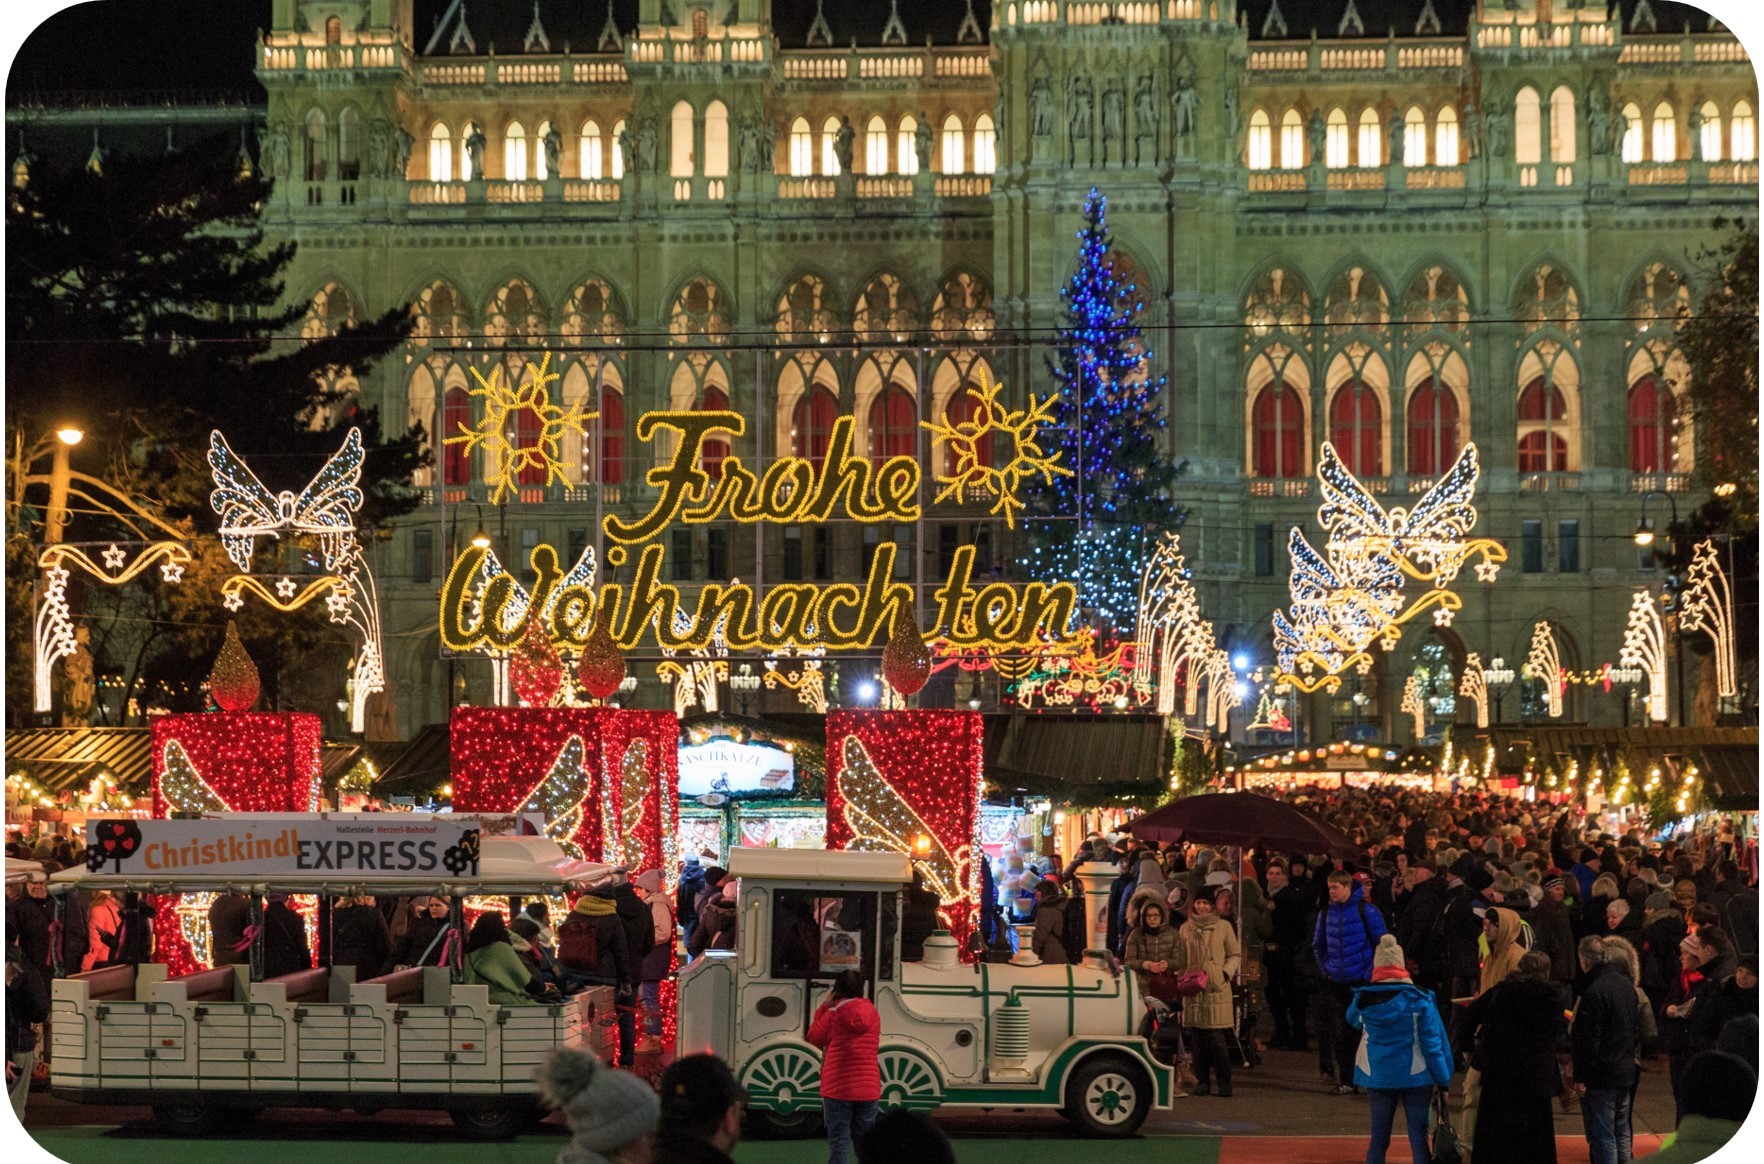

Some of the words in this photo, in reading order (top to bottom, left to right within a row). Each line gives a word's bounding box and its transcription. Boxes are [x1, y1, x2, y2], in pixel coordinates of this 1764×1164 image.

[602, 410, 922, 545] Frohe
[440, 543, 1083, 650] Weihnachten
[144, 828, 300, 870] Christkindl
[297, 840, 438, 871] EXPRESS
[336, 826, 374, 834] Haltestelle
[377, 826, 437, 834] Herzerl-Bahnhof
